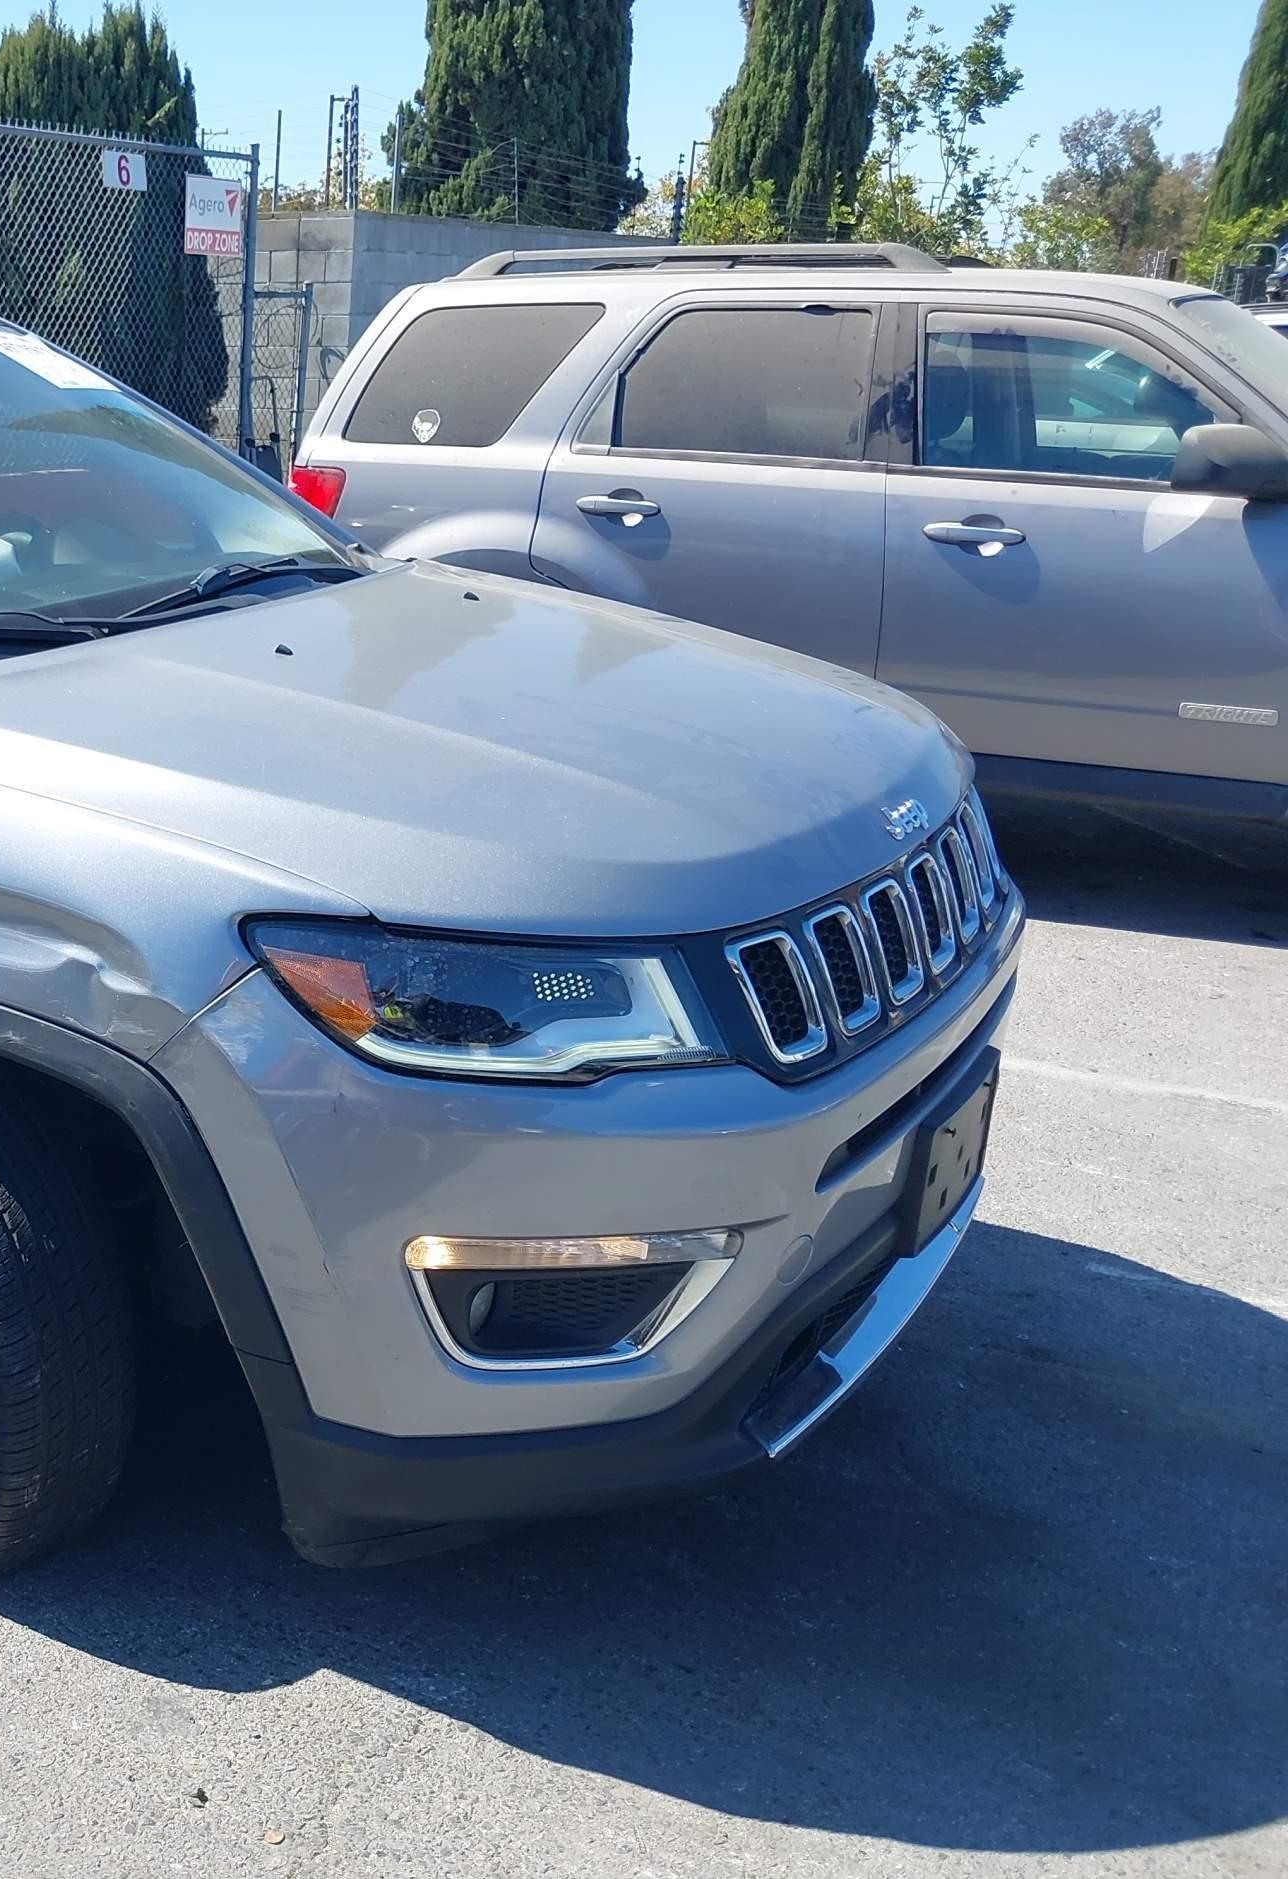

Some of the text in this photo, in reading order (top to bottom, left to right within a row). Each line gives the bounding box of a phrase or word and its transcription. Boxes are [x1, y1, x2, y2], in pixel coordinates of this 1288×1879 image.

[117, 154, 130, 187] 6
[189, 192, 225, 217] Agero
[187, 231, 239, 253] DROP ZONE
[1186, 705, 1274, 725] TRIBUTE
[880, 799, 929, 840] Jeep
